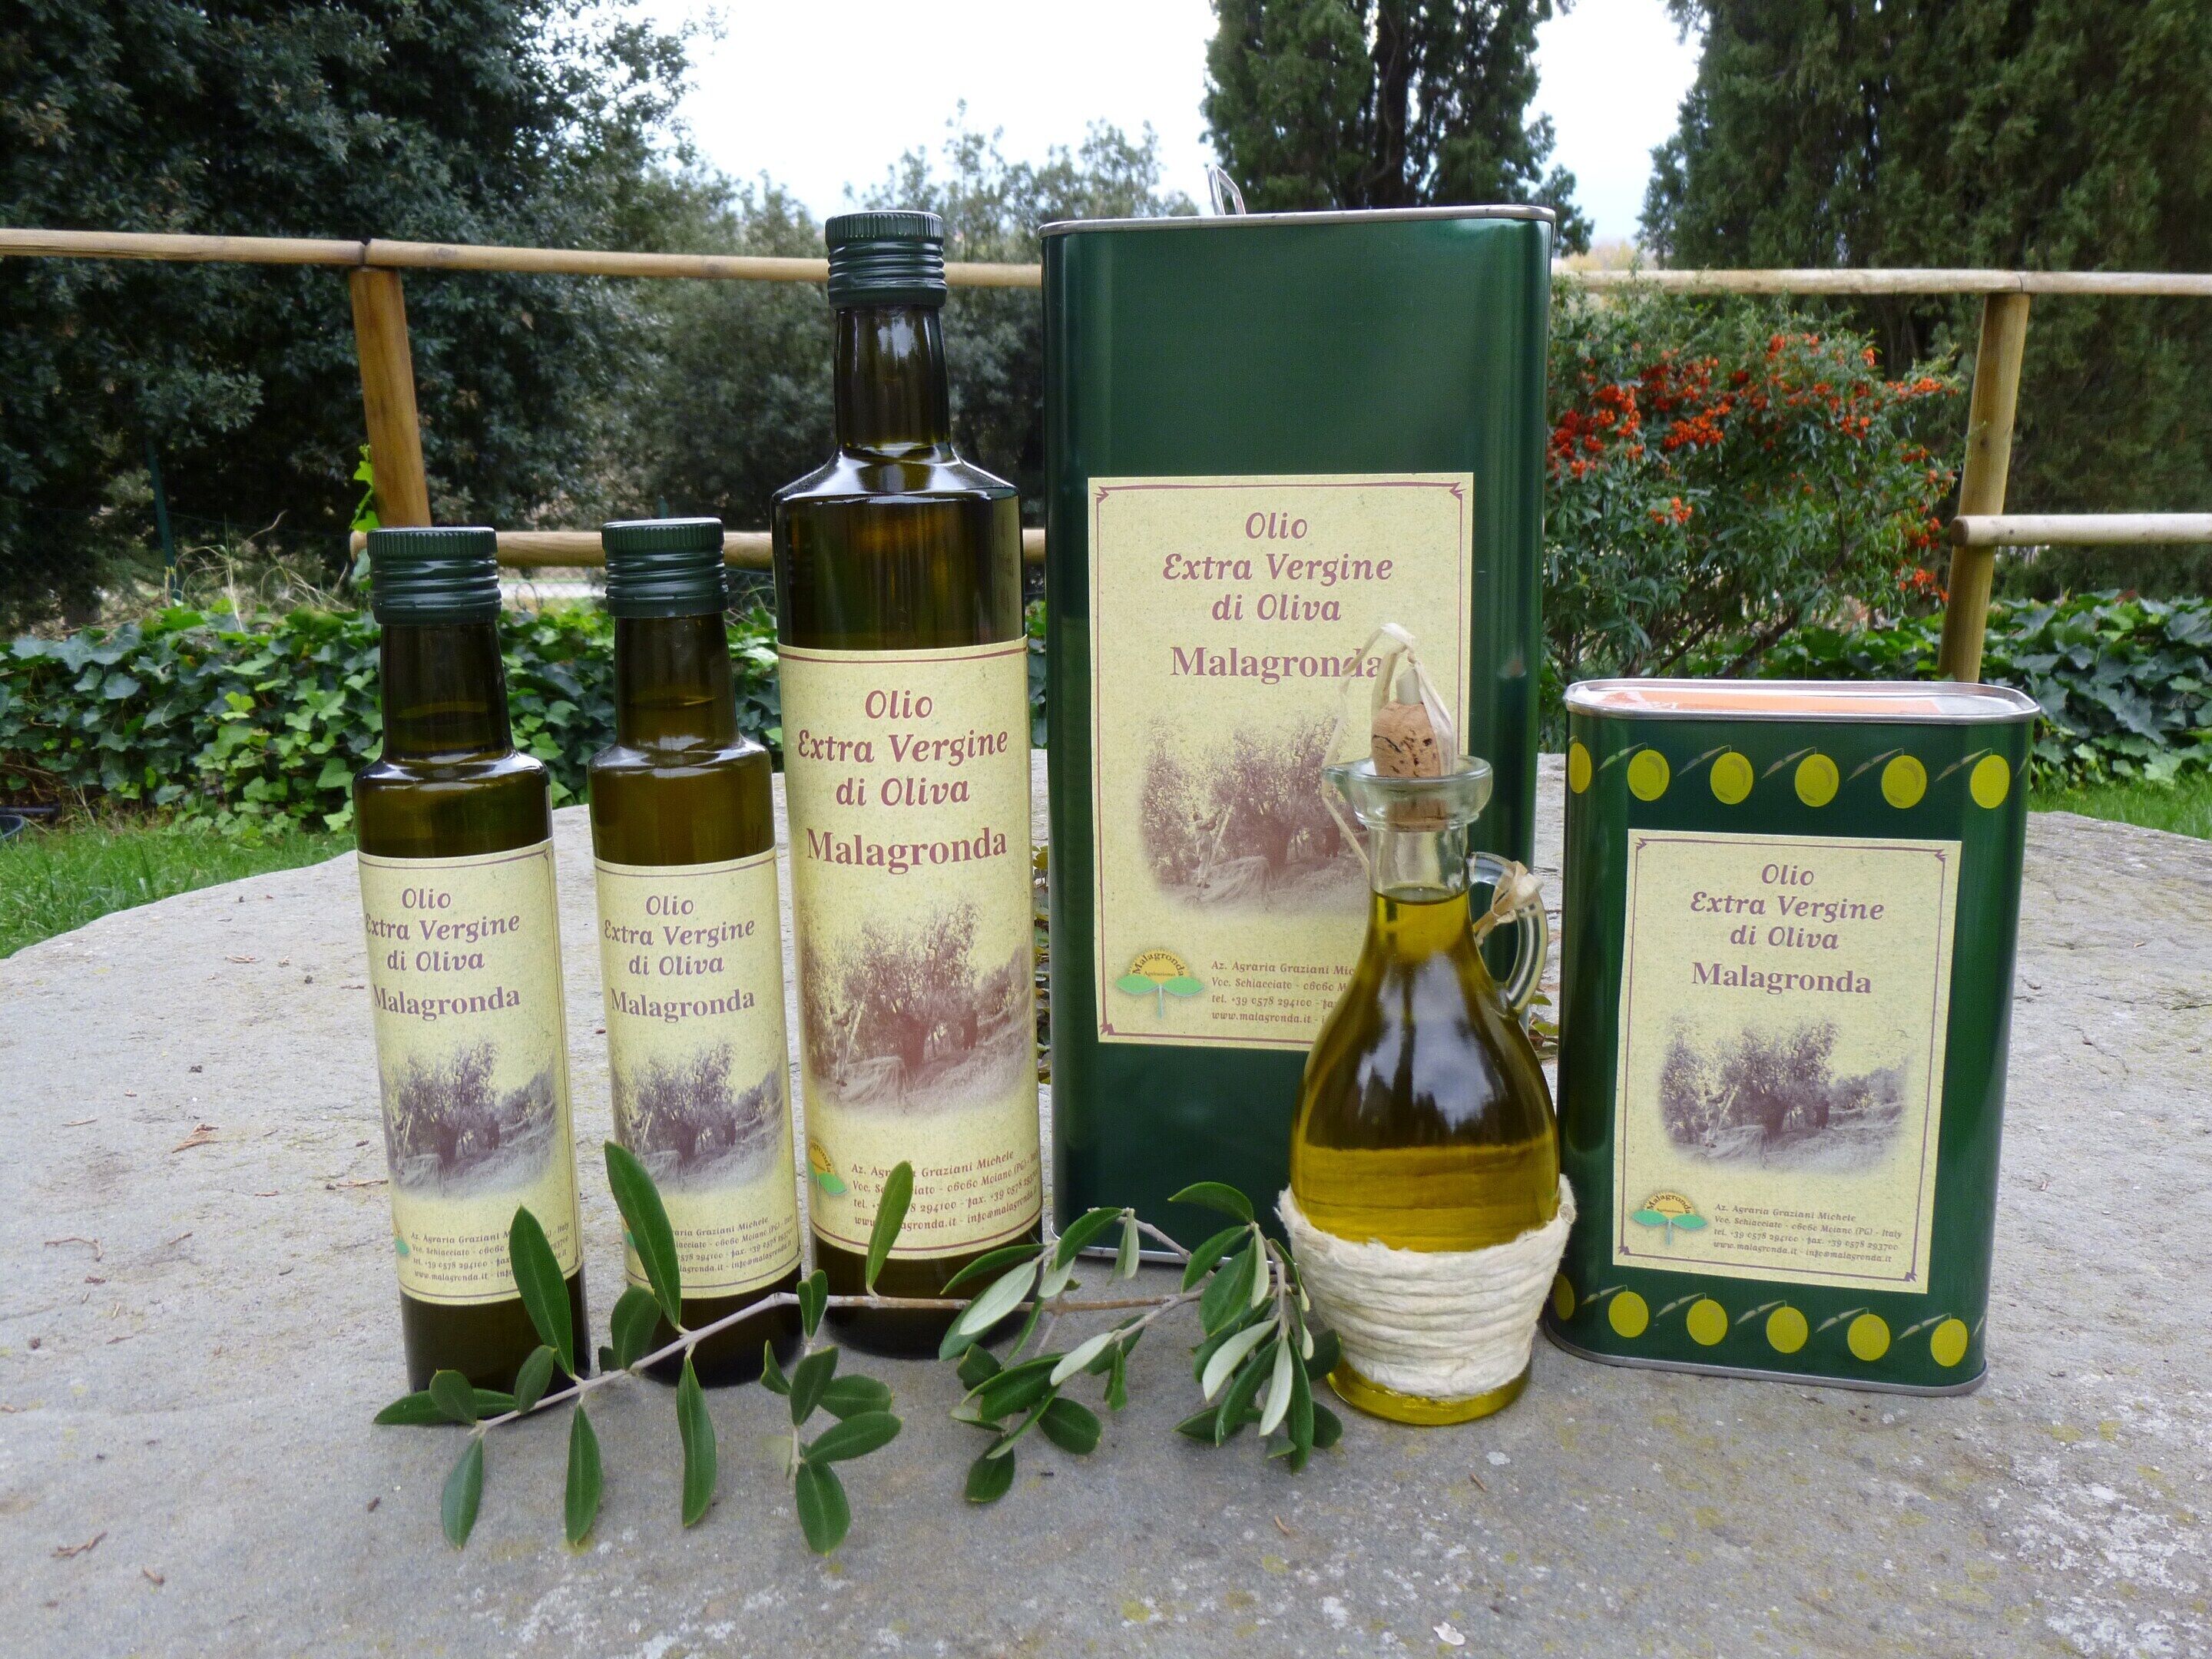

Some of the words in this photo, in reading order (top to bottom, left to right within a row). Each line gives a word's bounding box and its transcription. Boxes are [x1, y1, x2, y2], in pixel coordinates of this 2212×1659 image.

[1245, 512, 1307, 539] Olio
[1162, 553, 1252, 581] Extra
[1266, 553, 1392, 587] Vergine
[1212, 594, 1243, 621] di
[1257, 594, 1341, 621] Oliva
[1170, 647, 1382, 684] Malagronda
[865, 690, 932, 720] Olio
[798, 730, 874, 763] Extra
[889, 730, 1008, 767] Vergine
[836, 777, 866, 806] di
[881, 777, 970, 806] Oliva
[806, 826, 1007, 875] Malagronda
[1761, 863, 1814, 886] Olio
[402, 889, 451, 909] Olio
[646, 896, 694, 916] Olio
[1690, 891, 1766, 915] Extra
[1778, 895, 1884, 923] Vergine
[366, 913, 410, 940] Extra
[419, 916, 520, 943] Vergine
[604, 919, 654, 946] Extra
[663, 920, 755, 948] Vergine
[1730, 925, 1757, 945] di
[1768, 926, 1839, 949] Oliva
[387, 950, 407, 971] di
[416, 951, 485, 972] Oliva
[629, 955, 649, 975] di
[659, 956, 724, 975] Oliva
[1132, 952, 1184, 976] Malagronda
[1211, 961, 1227, 970] Az.
[1232, 961, 1276, 972] Agraria
[1280, 963, 1329, 975] Graziani
[1211, 977, 1231, 987] Voc.
[1235, 978, 1292, 989] Schiacciato
[1303, 981, 1333, 992] 06060
[1691, 962, 1872, 995] Malagronda
[373, 985, 521, 1021] Malagronda
[611, 988, 755, 1024] Malagronda
[1212, 994, 1227, 1003] tel.
[1231, 996, 1247, 1006] +39
[1251, 995, 1274, 1007] 0578
[1277, 998, 1312, 1008] 294100
[1212, 1011, 1310, 1024] www.malagronda.it
[852, 1164, 866, 1174] Az.
[922, 1162, 972, 1177] Graziani
[977, 1151, 1014, 1171] Michele
[853, 1181, 870, 1192] Voc.
[875, 1184, 935, 1195] Sciato
[948, 1180, 979, 1193] 06060
[982, 1169, 1012, 1187] Moiano
[854, 1199, 868, 1209] tel.
[920, 1201, 956, 1214] 294100
[968, 1196, 986, 1208] fax.
[990, 1190, 1004, 1202] +39
[1732, 1205, 1769, 1214] Agraria
[1773, 1208, 1814, 1219] Graziani
[1818, 1212, 1856, 1222] Michele
[423, 1234, 455, 1243] Agraria
[459, 1233, 499, 1243] Graziani
[697, 1226, 734, 1237] Graziani
[738, 1217, 769, 1231] Michele
[1714, 1215, 1731, 1224] Voc.
[1734, 1217, 1782, 1229] Schiacciato
[1820, 1224, 1853, 1234] Moiano
[1856, 1227, 1873, 1236] (PG)
[1882, 1229, 1902, 1240] Italy
[1747, 1232, 1767, 1241] 0578
[426, 1245, 470, 1256] Schiacciato
[1714, 1241, 1798, 1255] www.malagronda.it
[1806, 1250, 1892, 1263] info@malagronda.it
[680, 1263, 723, 1273] lagronda.it
